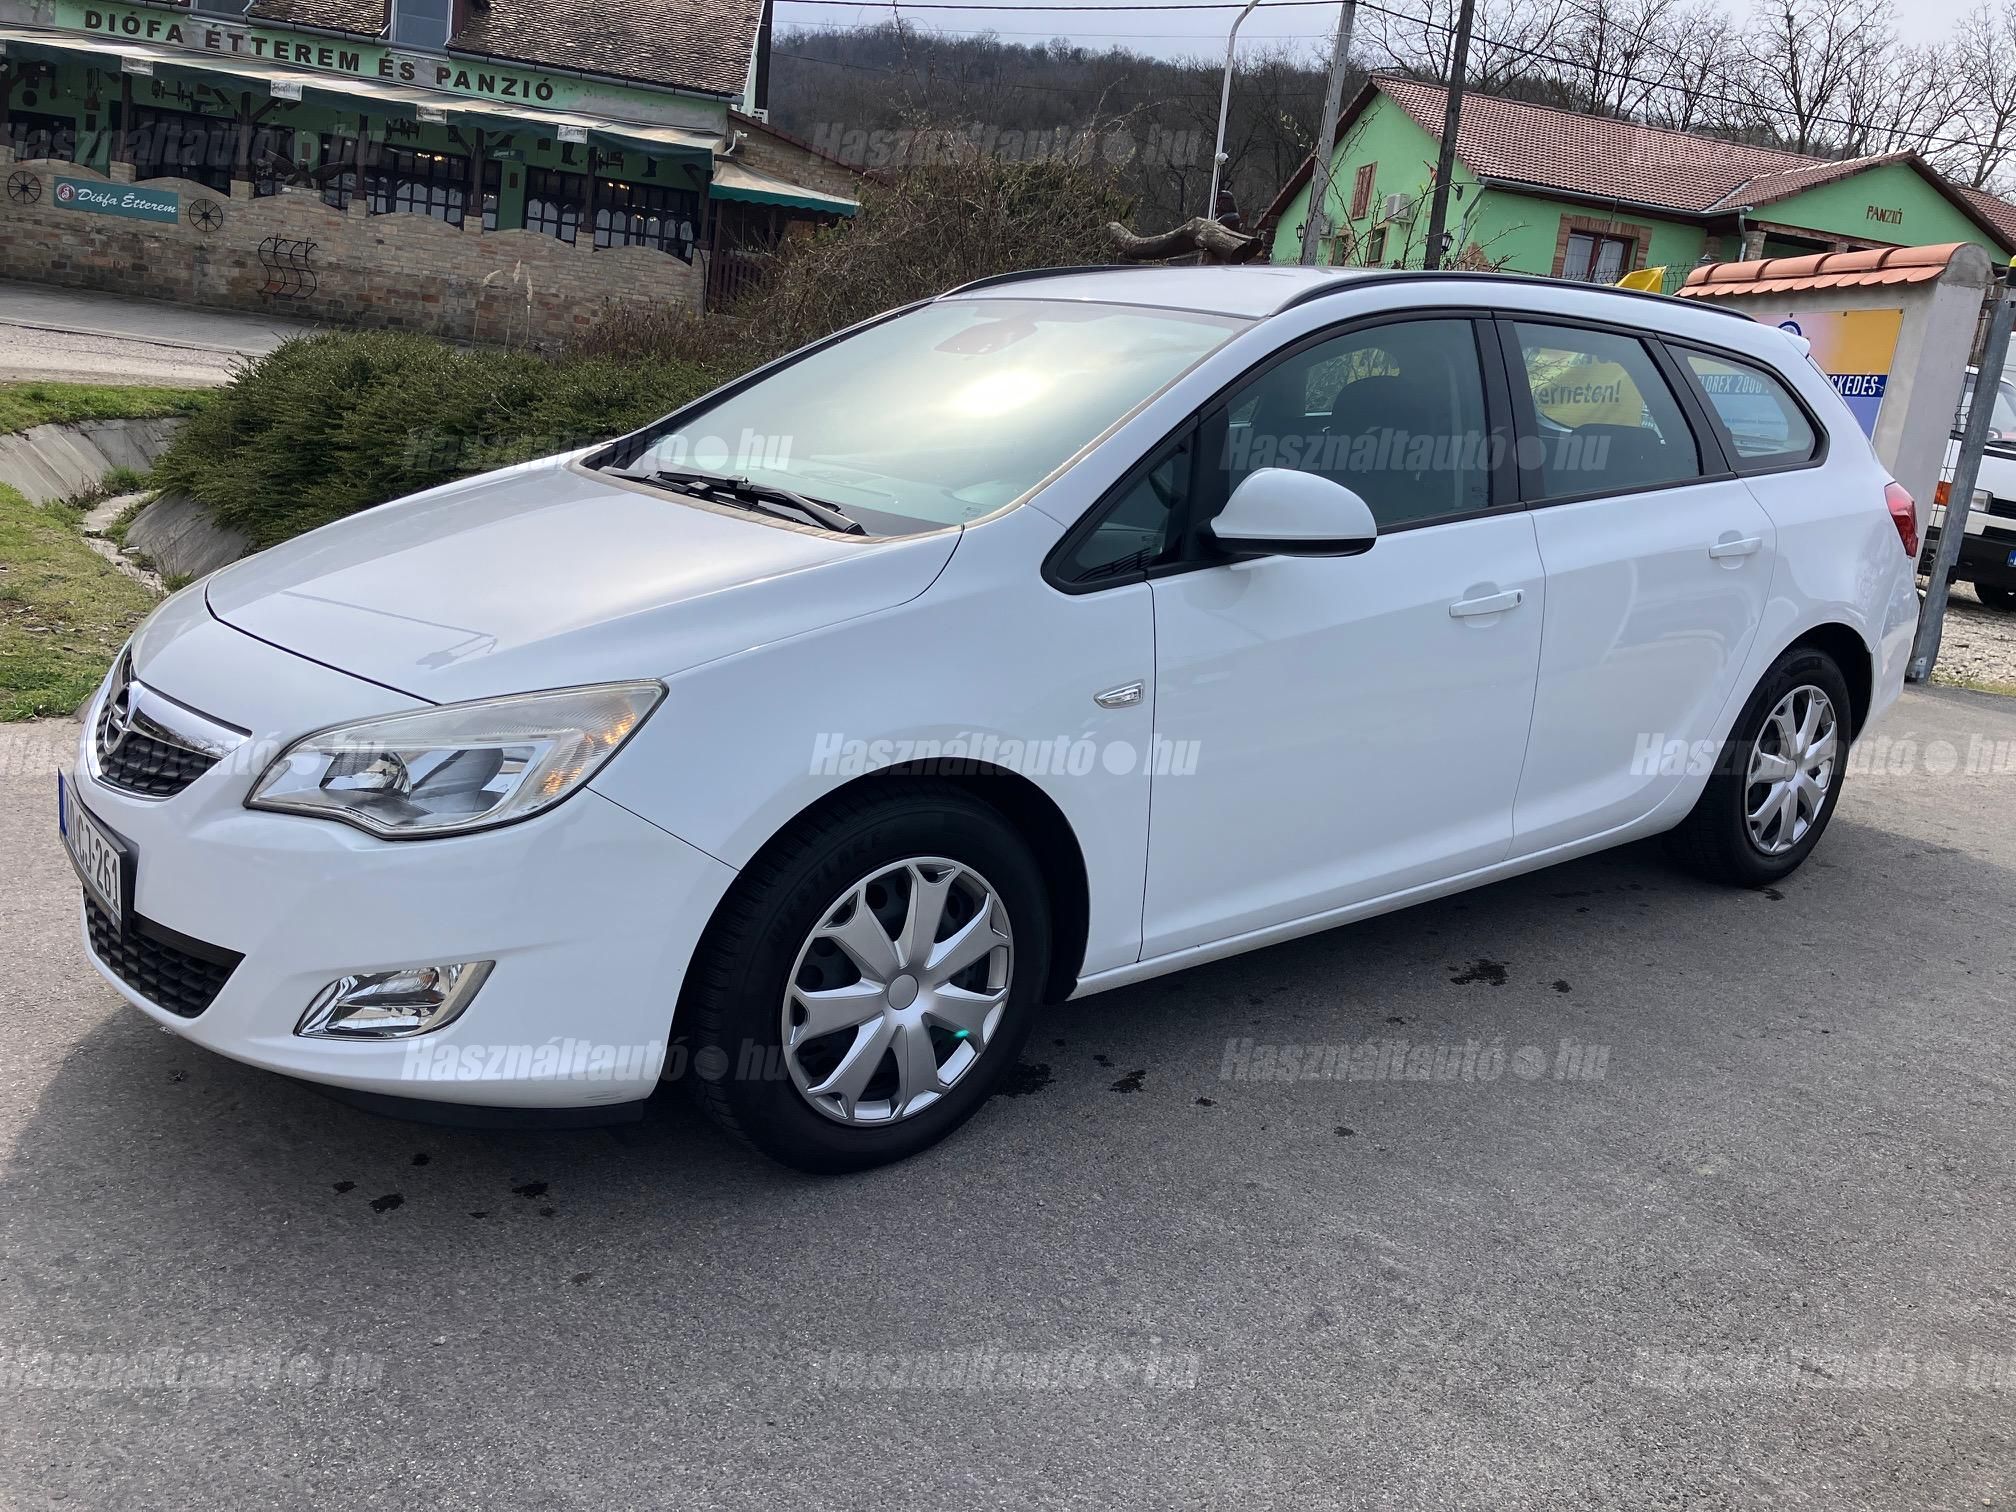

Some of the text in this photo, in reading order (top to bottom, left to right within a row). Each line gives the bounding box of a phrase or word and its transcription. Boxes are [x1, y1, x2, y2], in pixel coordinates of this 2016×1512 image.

[85, 9, 184, 44] DIÓFA
[379, 51, 415, 81] ÉS
[436, 66, 553, 101] PANZIÓ
[77, 188, 118, 207] Diófa
[1866, 205, 1903, 224] PANZIÓ
[1535, 379, 1622, 405] erneten!
